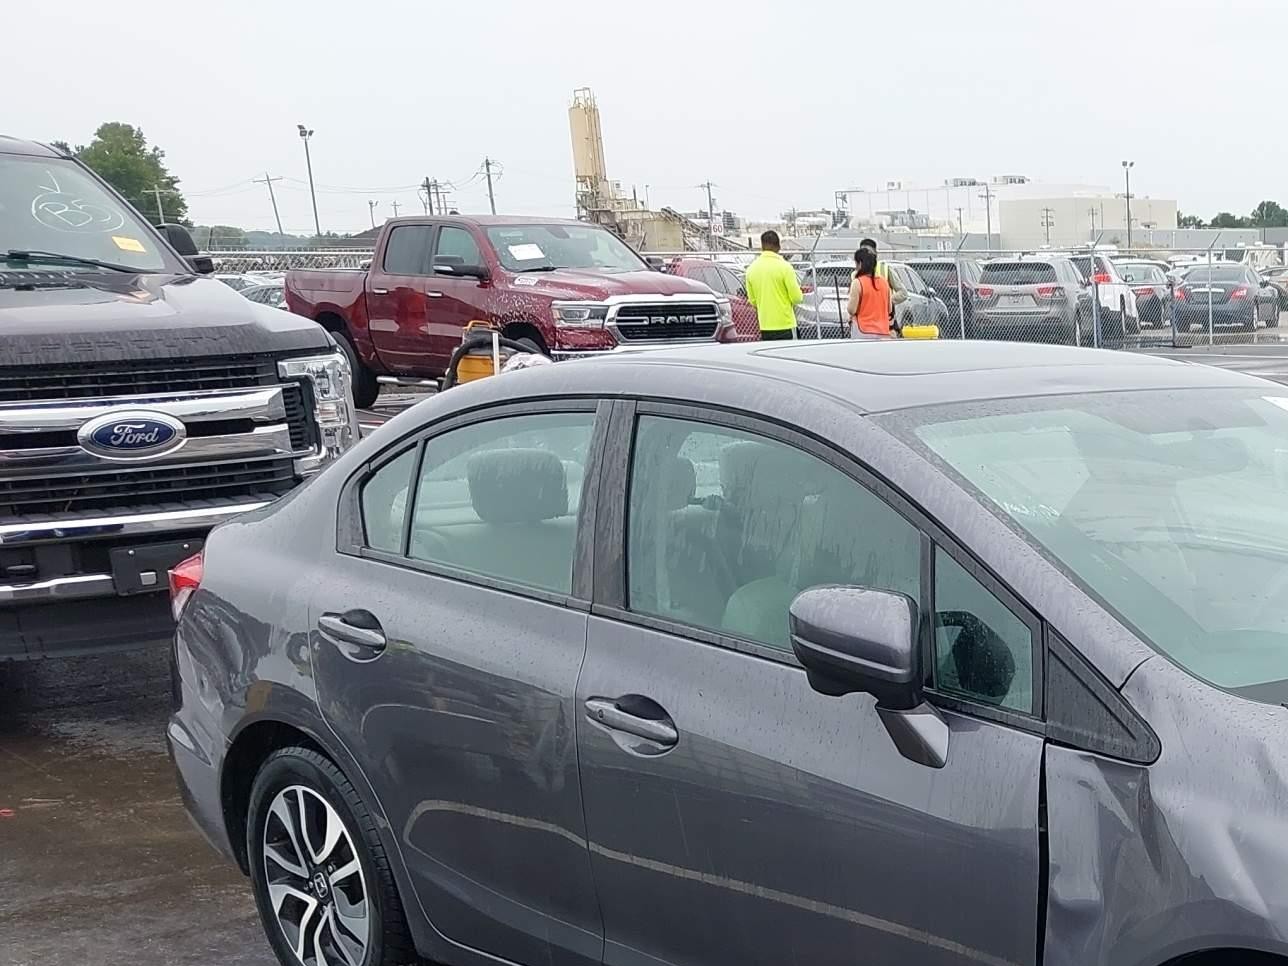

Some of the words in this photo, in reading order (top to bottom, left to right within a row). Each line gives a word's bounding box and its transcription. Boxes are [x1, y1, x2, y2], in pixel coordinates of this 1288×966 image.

[712, 224, 723, 233] 60
[651, 315, 693, 325] RAM
[110, 423, 160, 446] Ford
